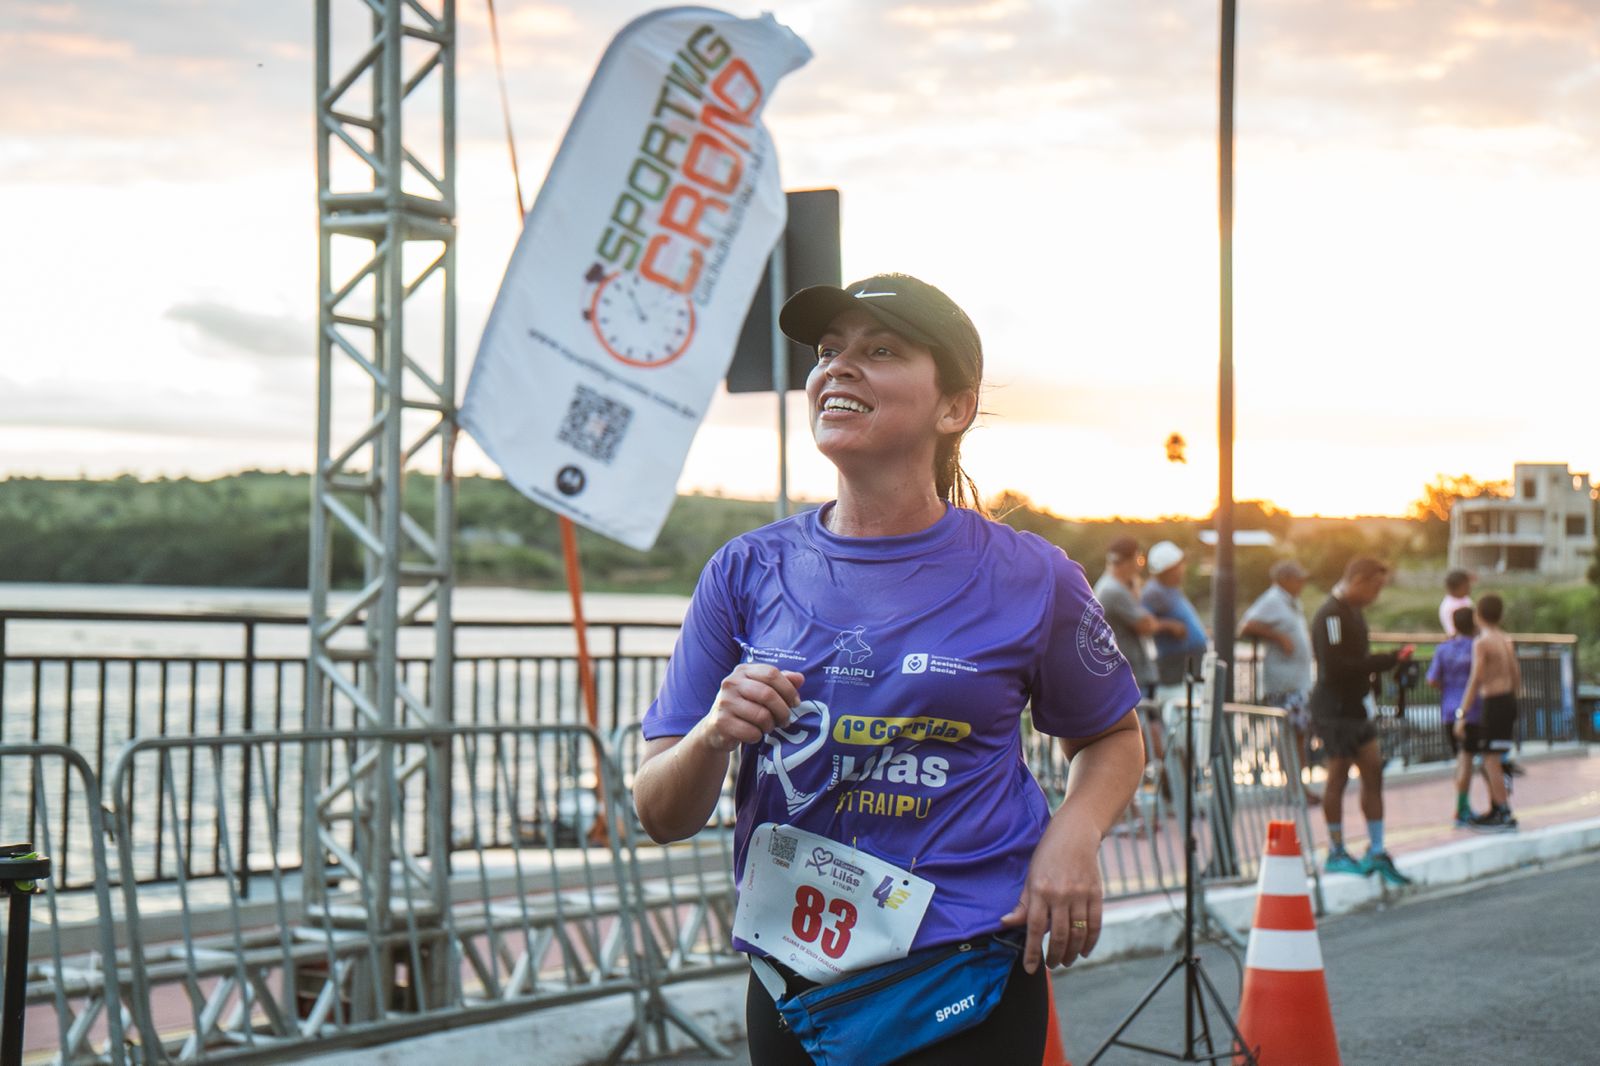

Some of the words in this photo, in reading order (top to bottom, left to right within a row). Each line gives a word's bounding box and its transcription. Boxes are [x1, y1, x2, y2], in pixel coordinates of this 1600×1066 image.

[639, 57, 763, 295] CRONO
[822, 666, 875, 678] TRAIPU
[930, 666, 956, 675] Social
[869, 719, 960, 740] Corrida
[832, 867, 860, 887] Lilás
[792, 885, 857, 959] 83
[935, 994, 975, 1022] SPORT
